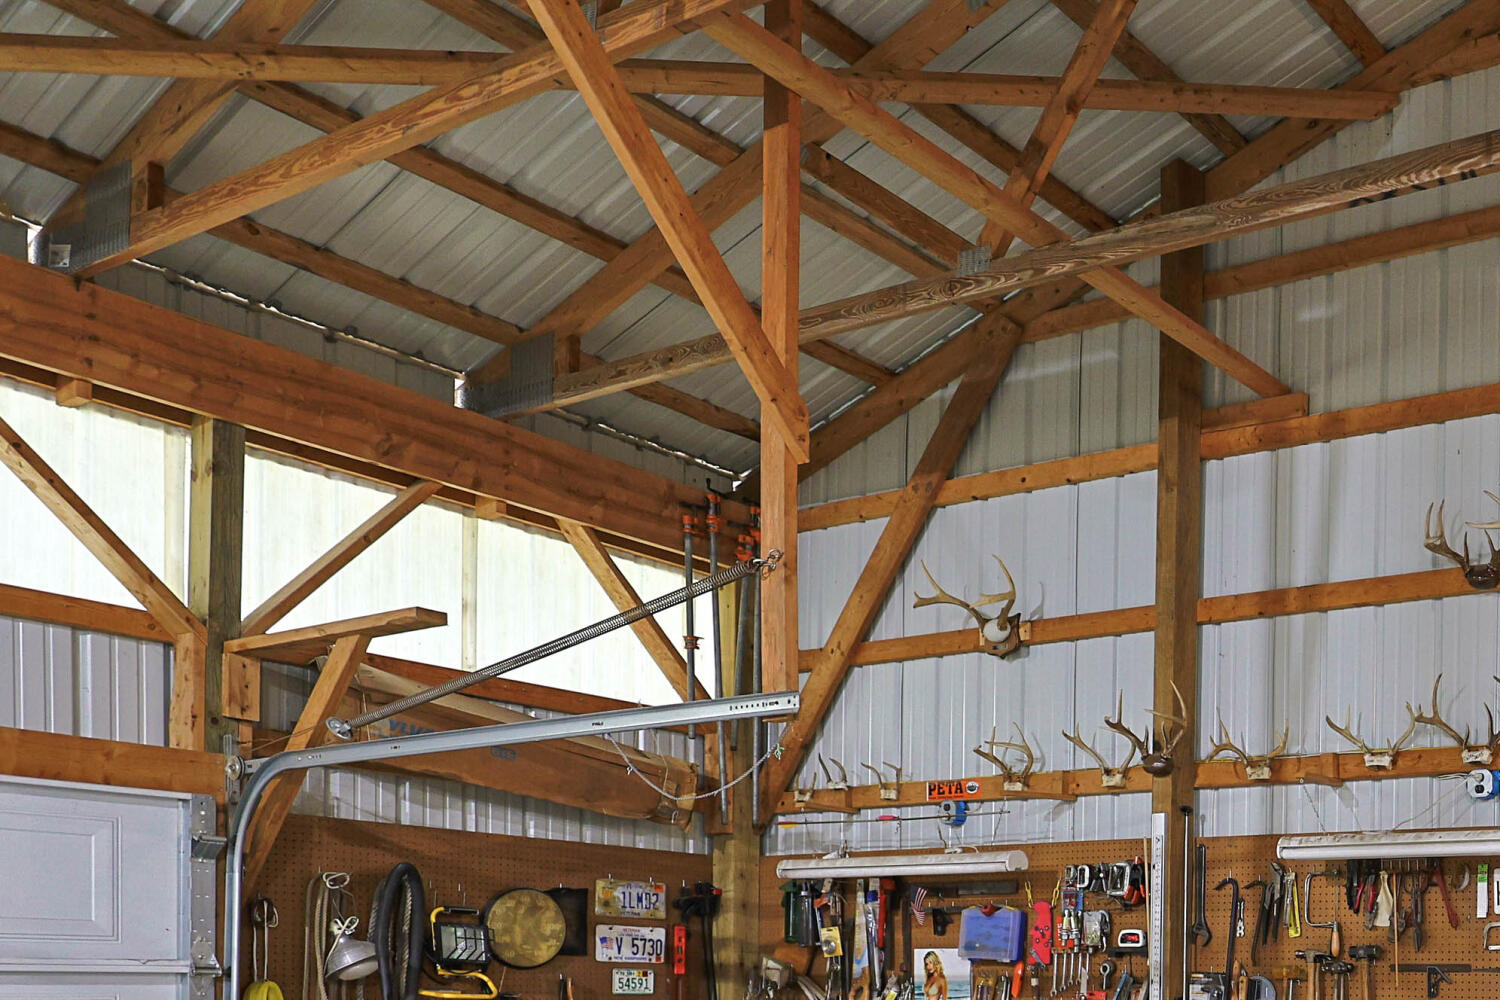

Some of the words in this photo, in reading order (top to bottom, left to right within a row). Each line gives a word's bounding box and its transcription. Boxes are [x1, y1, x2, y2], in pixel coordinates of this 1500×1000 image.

[928, 781, 964, 796] PETA
[615, 936, 623, 955] V
[631, 938, 663, 957] 5730
[618, 977, 650, 991] 54591
